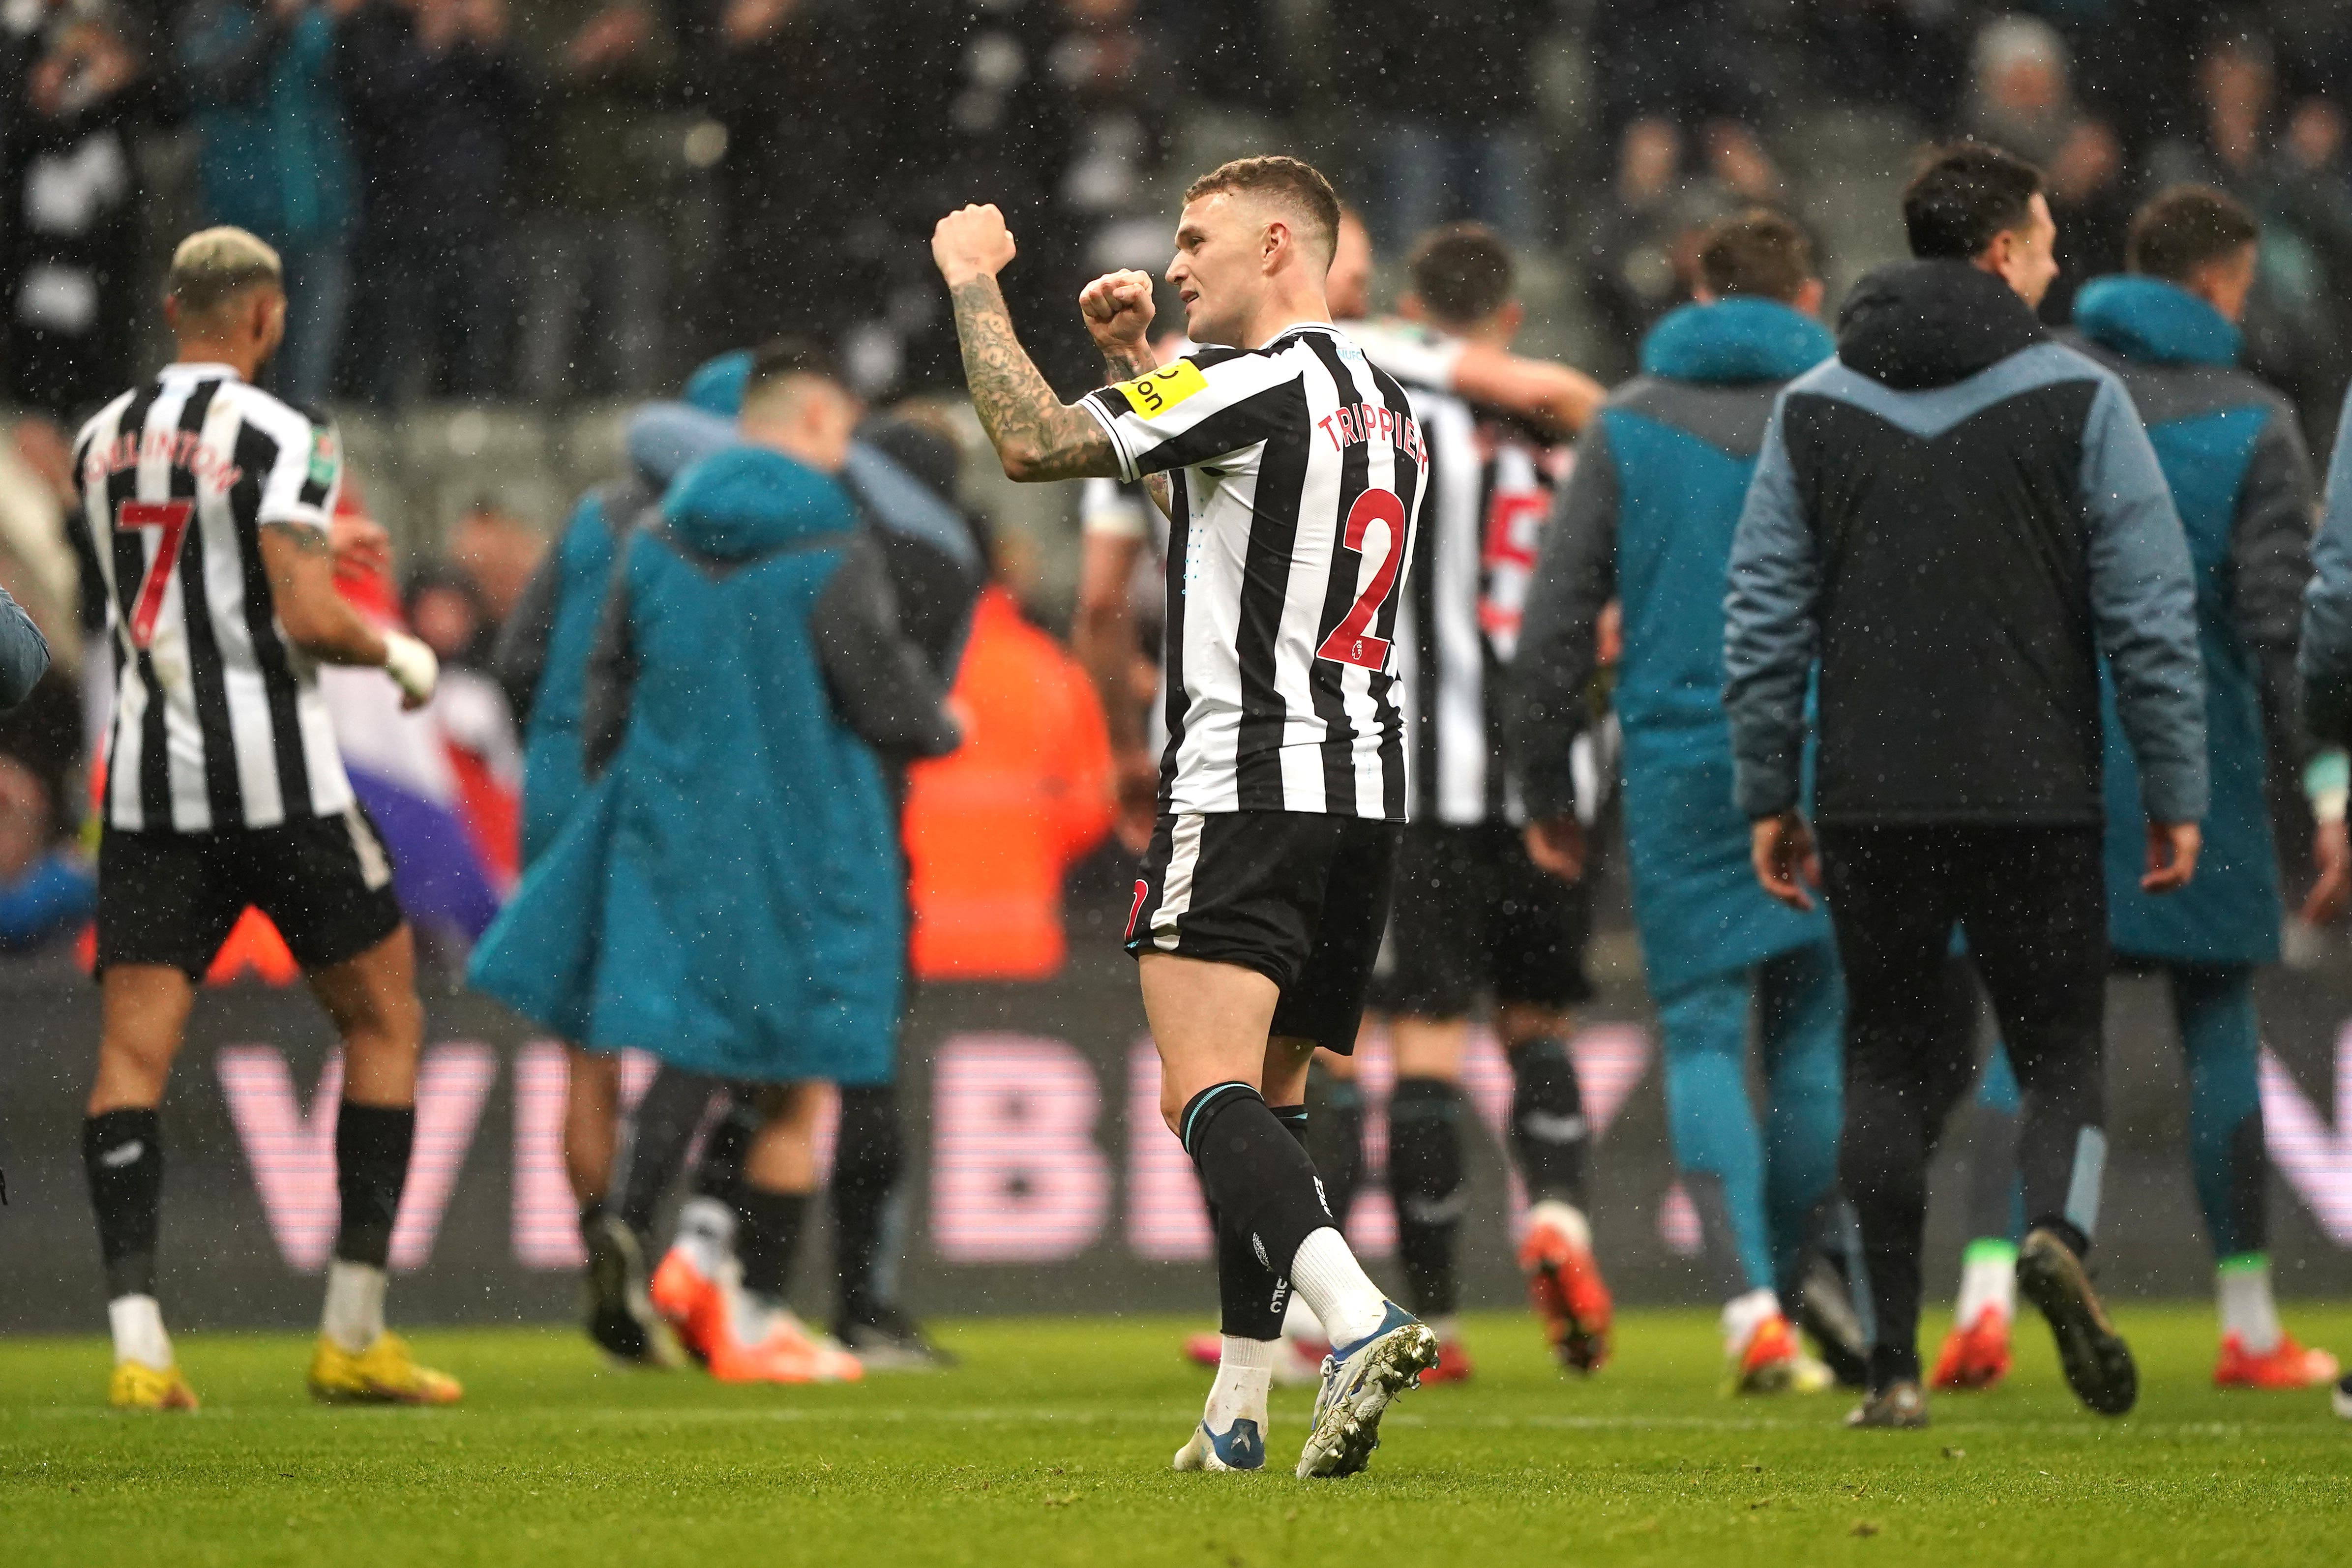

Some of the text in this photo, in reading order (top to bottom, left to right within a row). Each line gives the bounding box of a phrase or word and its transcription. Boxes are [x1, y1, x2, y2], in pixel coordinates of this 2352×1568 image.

[1337, 348, 1364, 361] NUFC
[1133, 380, 1163, 412] on
[1317, 402, 1428, 475] TRIPPIER
[117, 495, 195, 649] 7
[1316, 488, 1405, 672] 2
